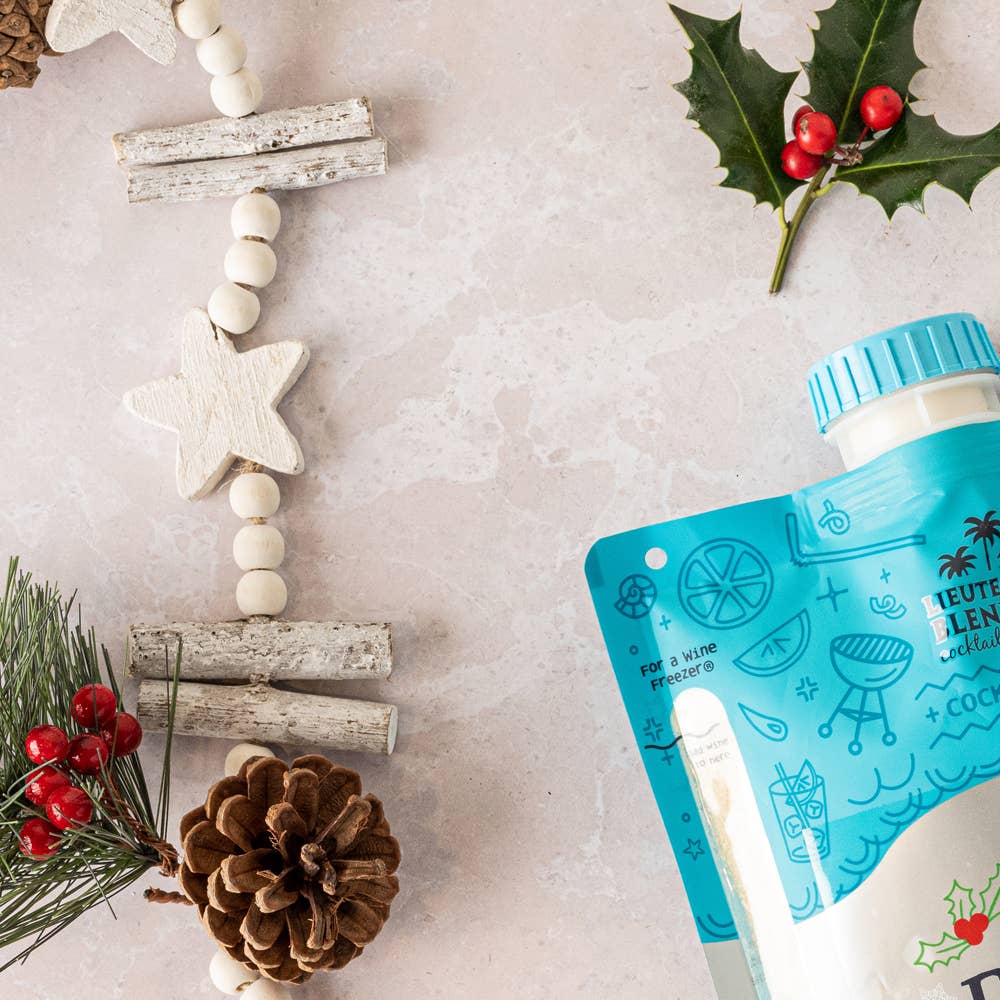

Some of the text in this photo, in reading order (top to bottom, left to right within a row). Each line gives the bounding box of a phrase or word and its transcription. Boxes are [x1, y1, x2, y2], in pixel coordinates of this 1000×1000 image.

[640, 643, 717, 677] For a Wine
